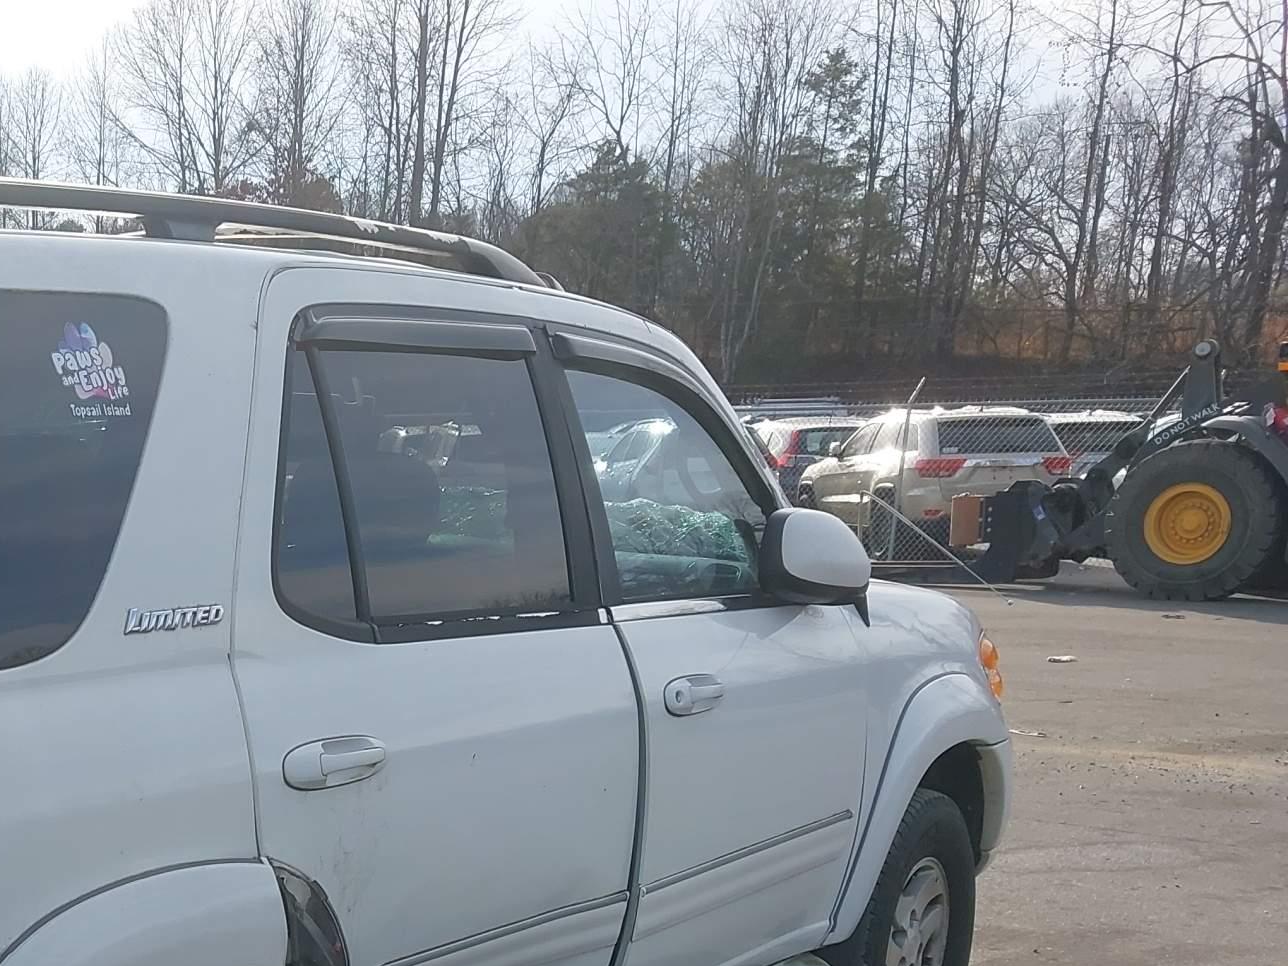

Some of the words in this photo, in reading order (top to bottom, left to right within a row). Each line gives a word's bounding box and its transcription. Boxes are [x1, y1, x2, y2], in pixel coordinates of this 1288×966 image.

[51, 346, 103, 375] Paws
[62, 371, 80, 386] and
[78, 365, 126, 392] Enjoy
[108, 386, 129, 400] Life
[69, 403, 102, 418] Topsail
[103, 403, 132, 416] Island
[1154, 430, 1170, 446] DO
[1170, 418, 1191, 435] NOT
[1192, 402, 1221, 421] WALK
